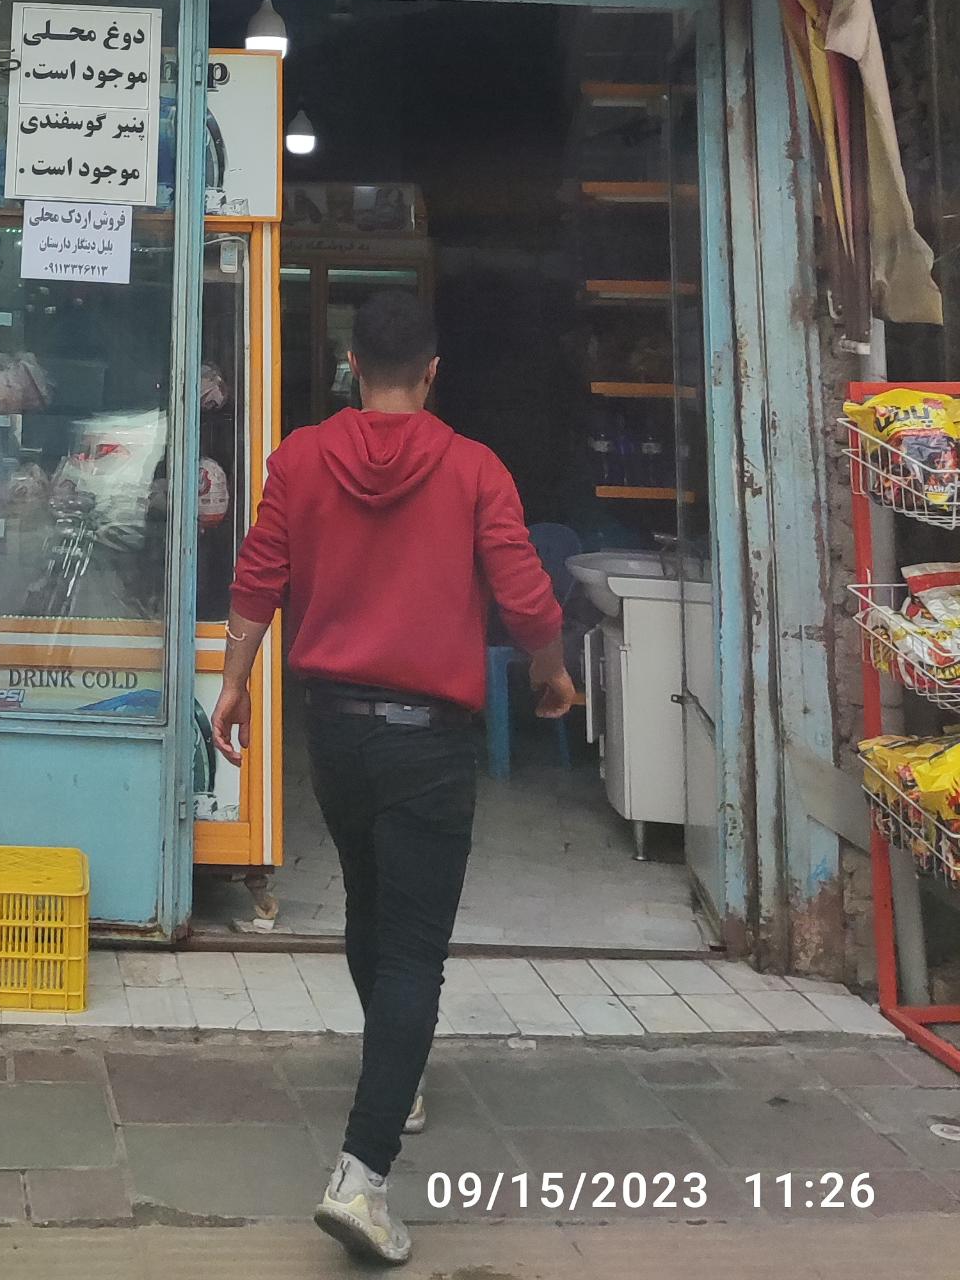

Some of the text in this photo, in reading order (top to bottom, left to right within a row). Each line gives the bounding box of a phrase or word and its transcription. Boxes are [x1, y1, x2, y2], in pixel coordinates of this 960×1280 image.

[24, 20, 145, 50] دوغ محلی
[82, 65, 148, 90] موجود
[20, 111, 145, 141] پنیر گوسفندی
[78, 161, 140, 186] موجود
[29, 206, 126, 231] فروش اردک محلی
[8, 668, 138, 689] DRINK COLD
